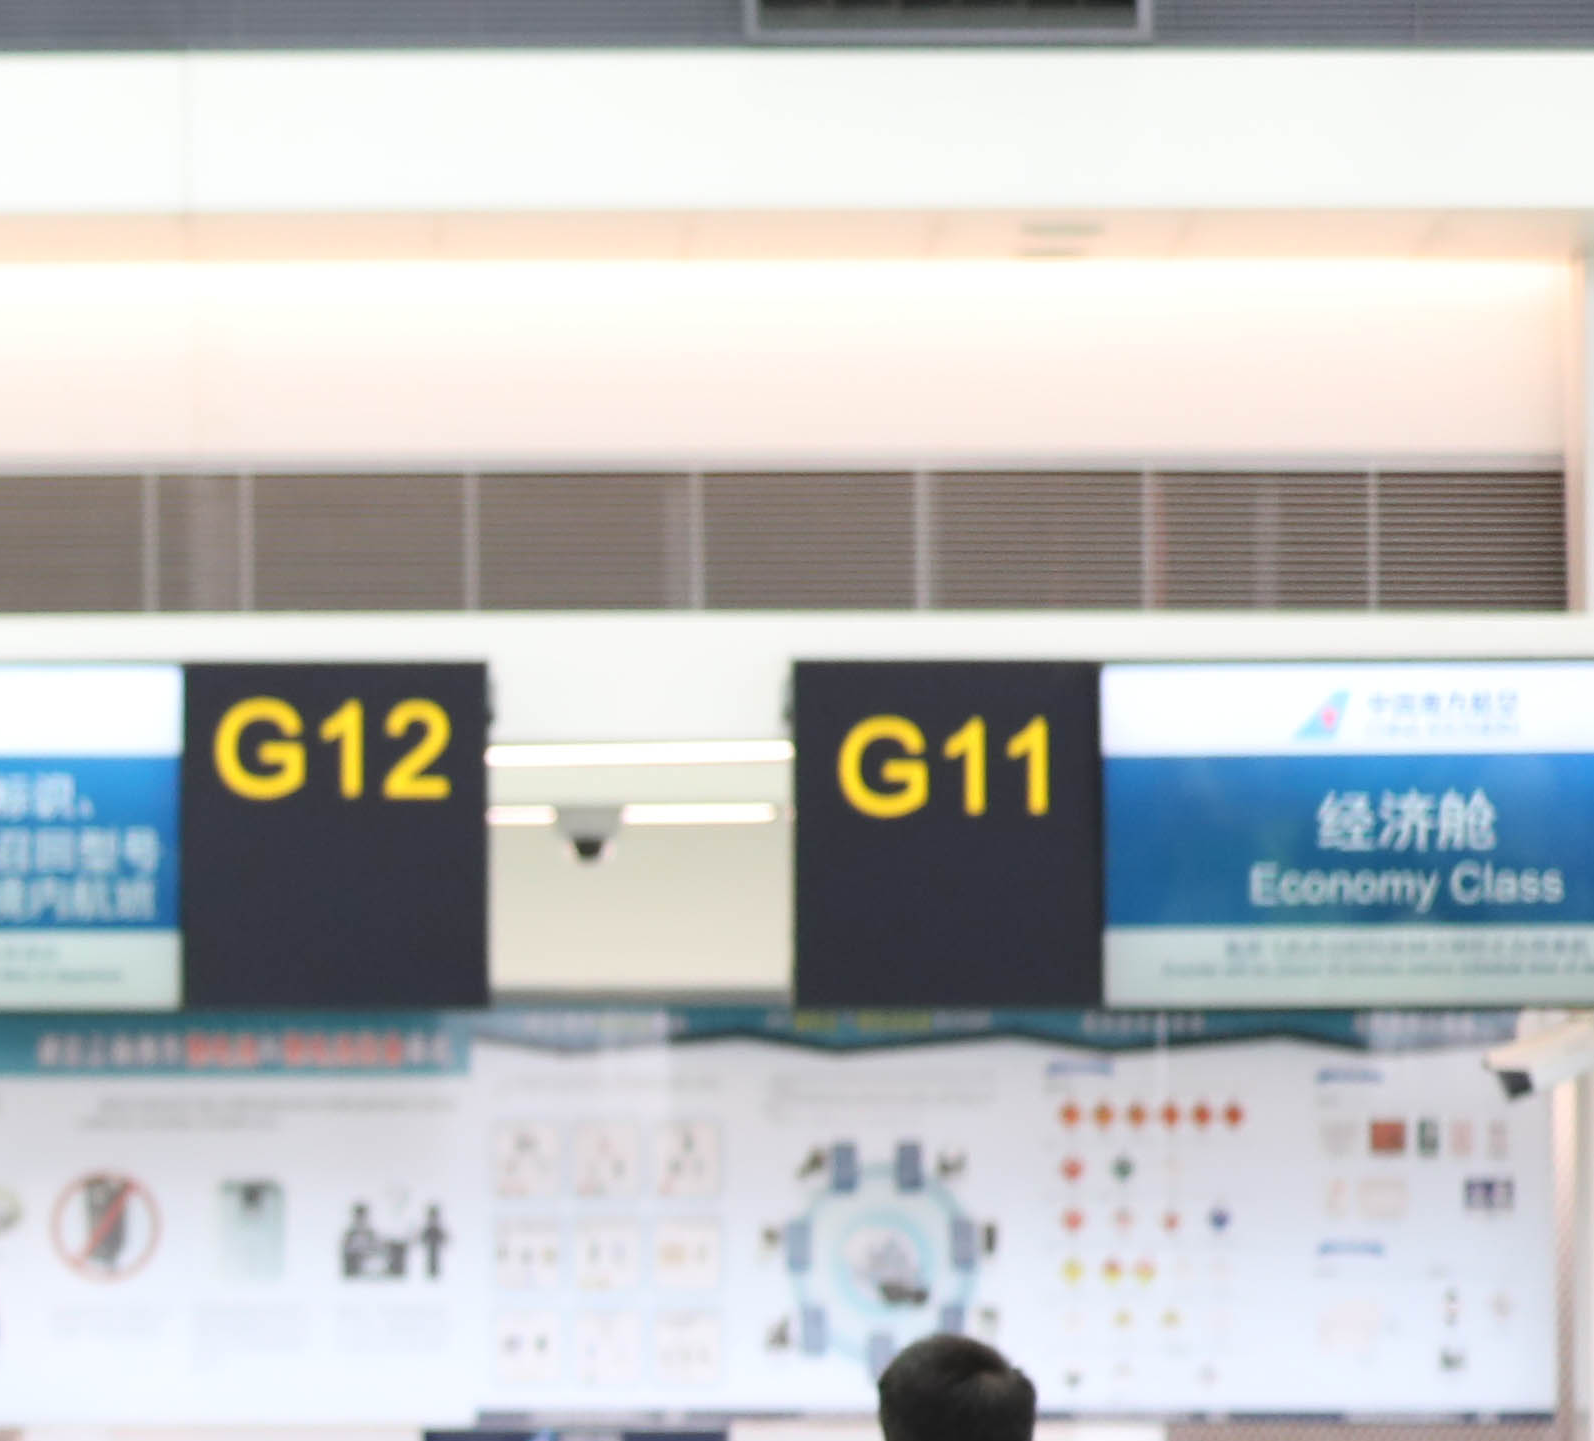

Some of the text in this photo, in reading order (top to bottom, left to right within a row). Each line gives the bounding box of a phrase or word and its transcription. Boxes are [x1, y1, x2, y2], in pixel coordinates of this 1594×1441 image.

[214, 697, 450, 800] G12
[838, 716, 1048, 818] G11
[1317, 787, 1497, 851] 经济舱
[1248, 859, 1565, 913] Economy Class
